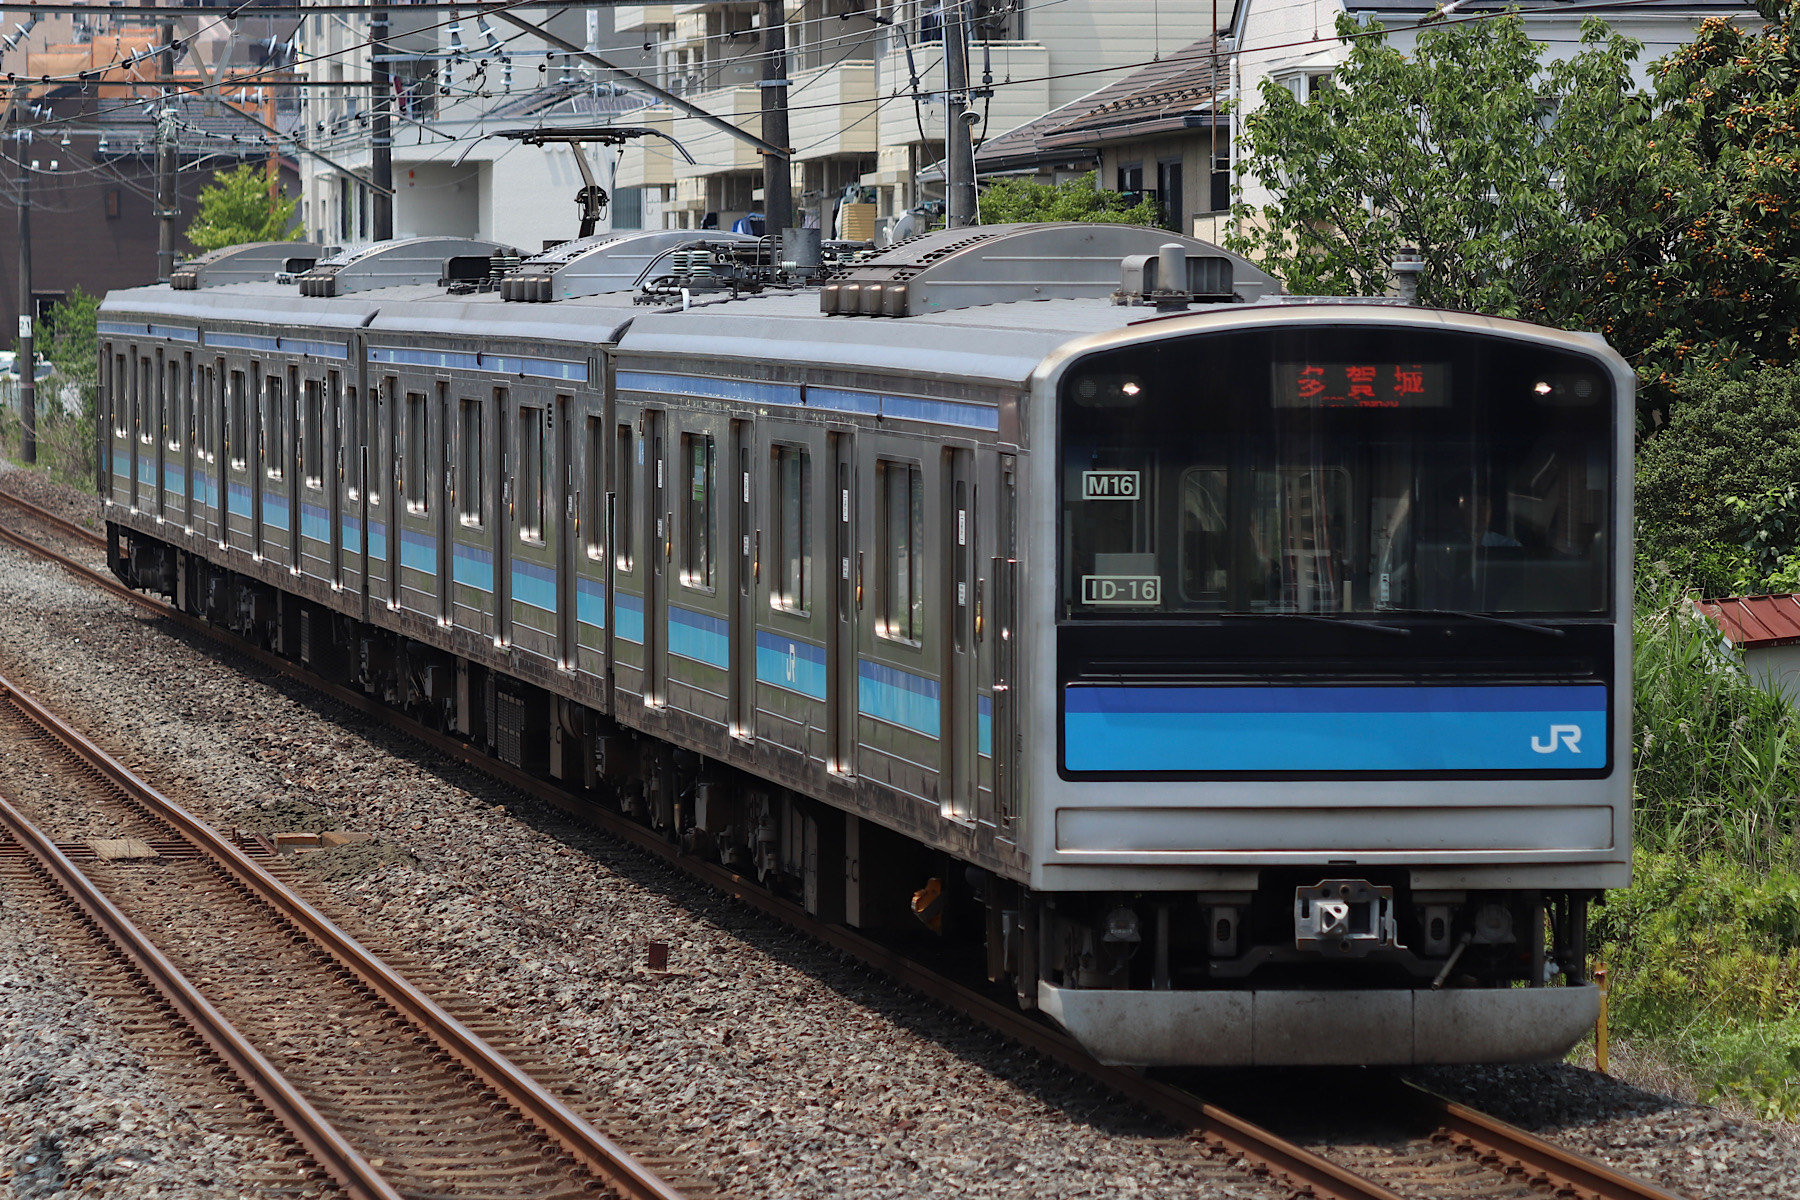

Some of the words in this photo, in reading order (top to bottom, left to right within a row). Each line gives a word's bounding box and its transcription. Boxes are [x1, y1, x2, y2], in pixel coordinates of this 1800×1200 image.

[1297, 365, 1425, 397] 多賀城
[1089, 476, 1134, 495] M16
[786, 643, 796, 683] JR
[1531, 725, 1582, 753] JR
